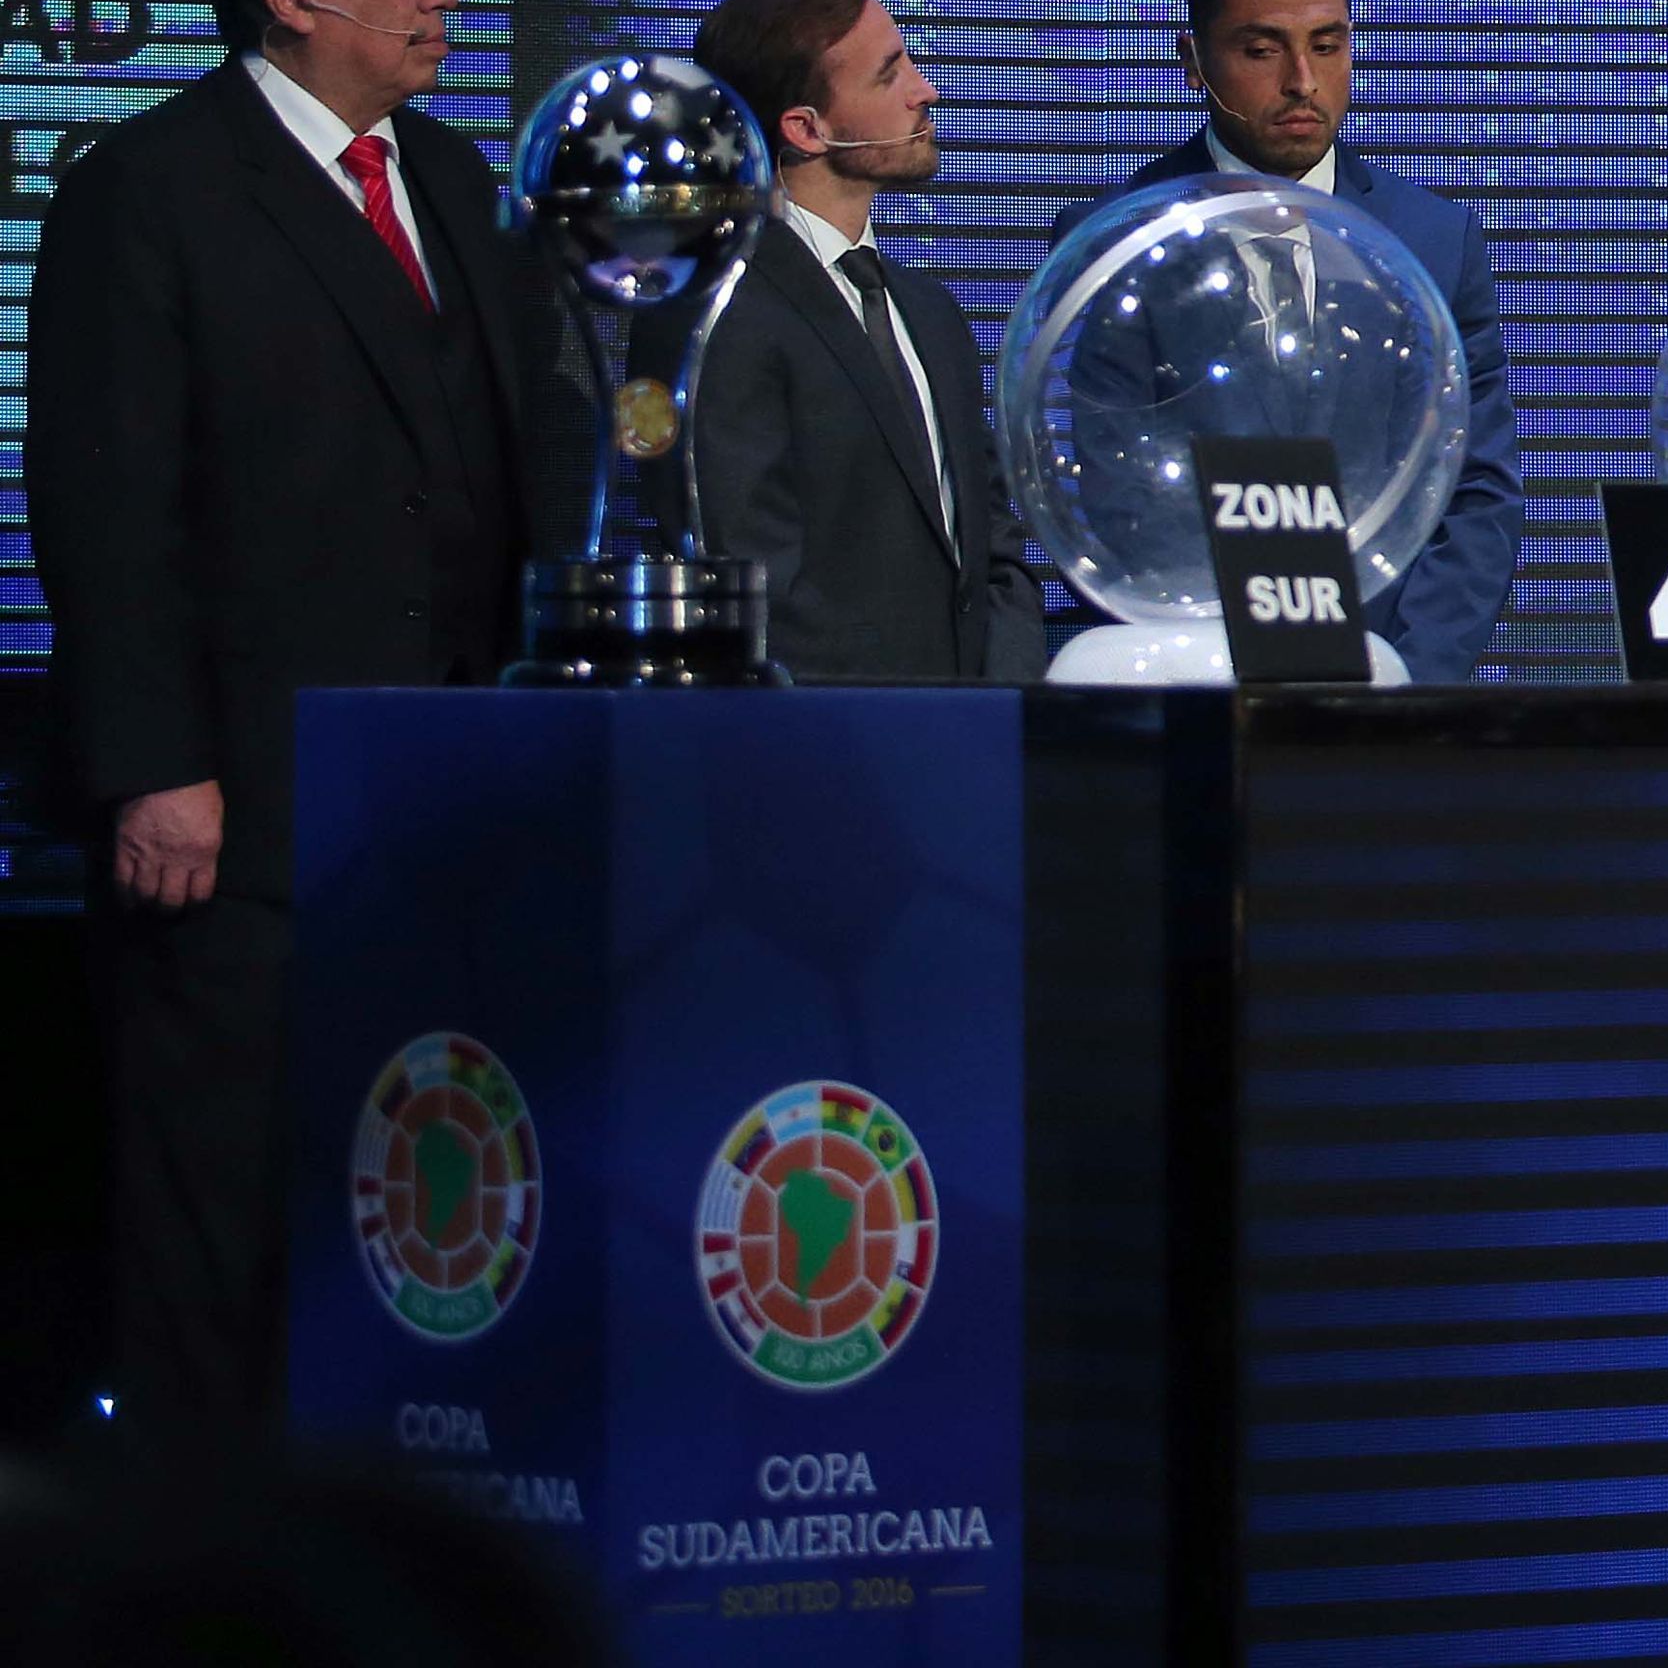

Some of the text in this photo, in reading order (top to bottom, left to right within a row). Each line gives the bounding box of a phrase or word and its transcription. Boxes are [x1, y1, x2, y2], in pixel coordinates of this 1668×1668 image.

[1210, 481, 1348, 531] ZONA
[1245, 575, 1348, 623] SUR
[396, 1402, 491, 1453] COPA
[758, 1451, 878, 1502] COPA
[638, 1505, 992, 1570] SUDAMERICANA
[719, 1577, 915, 1619] SORTEO 2016
